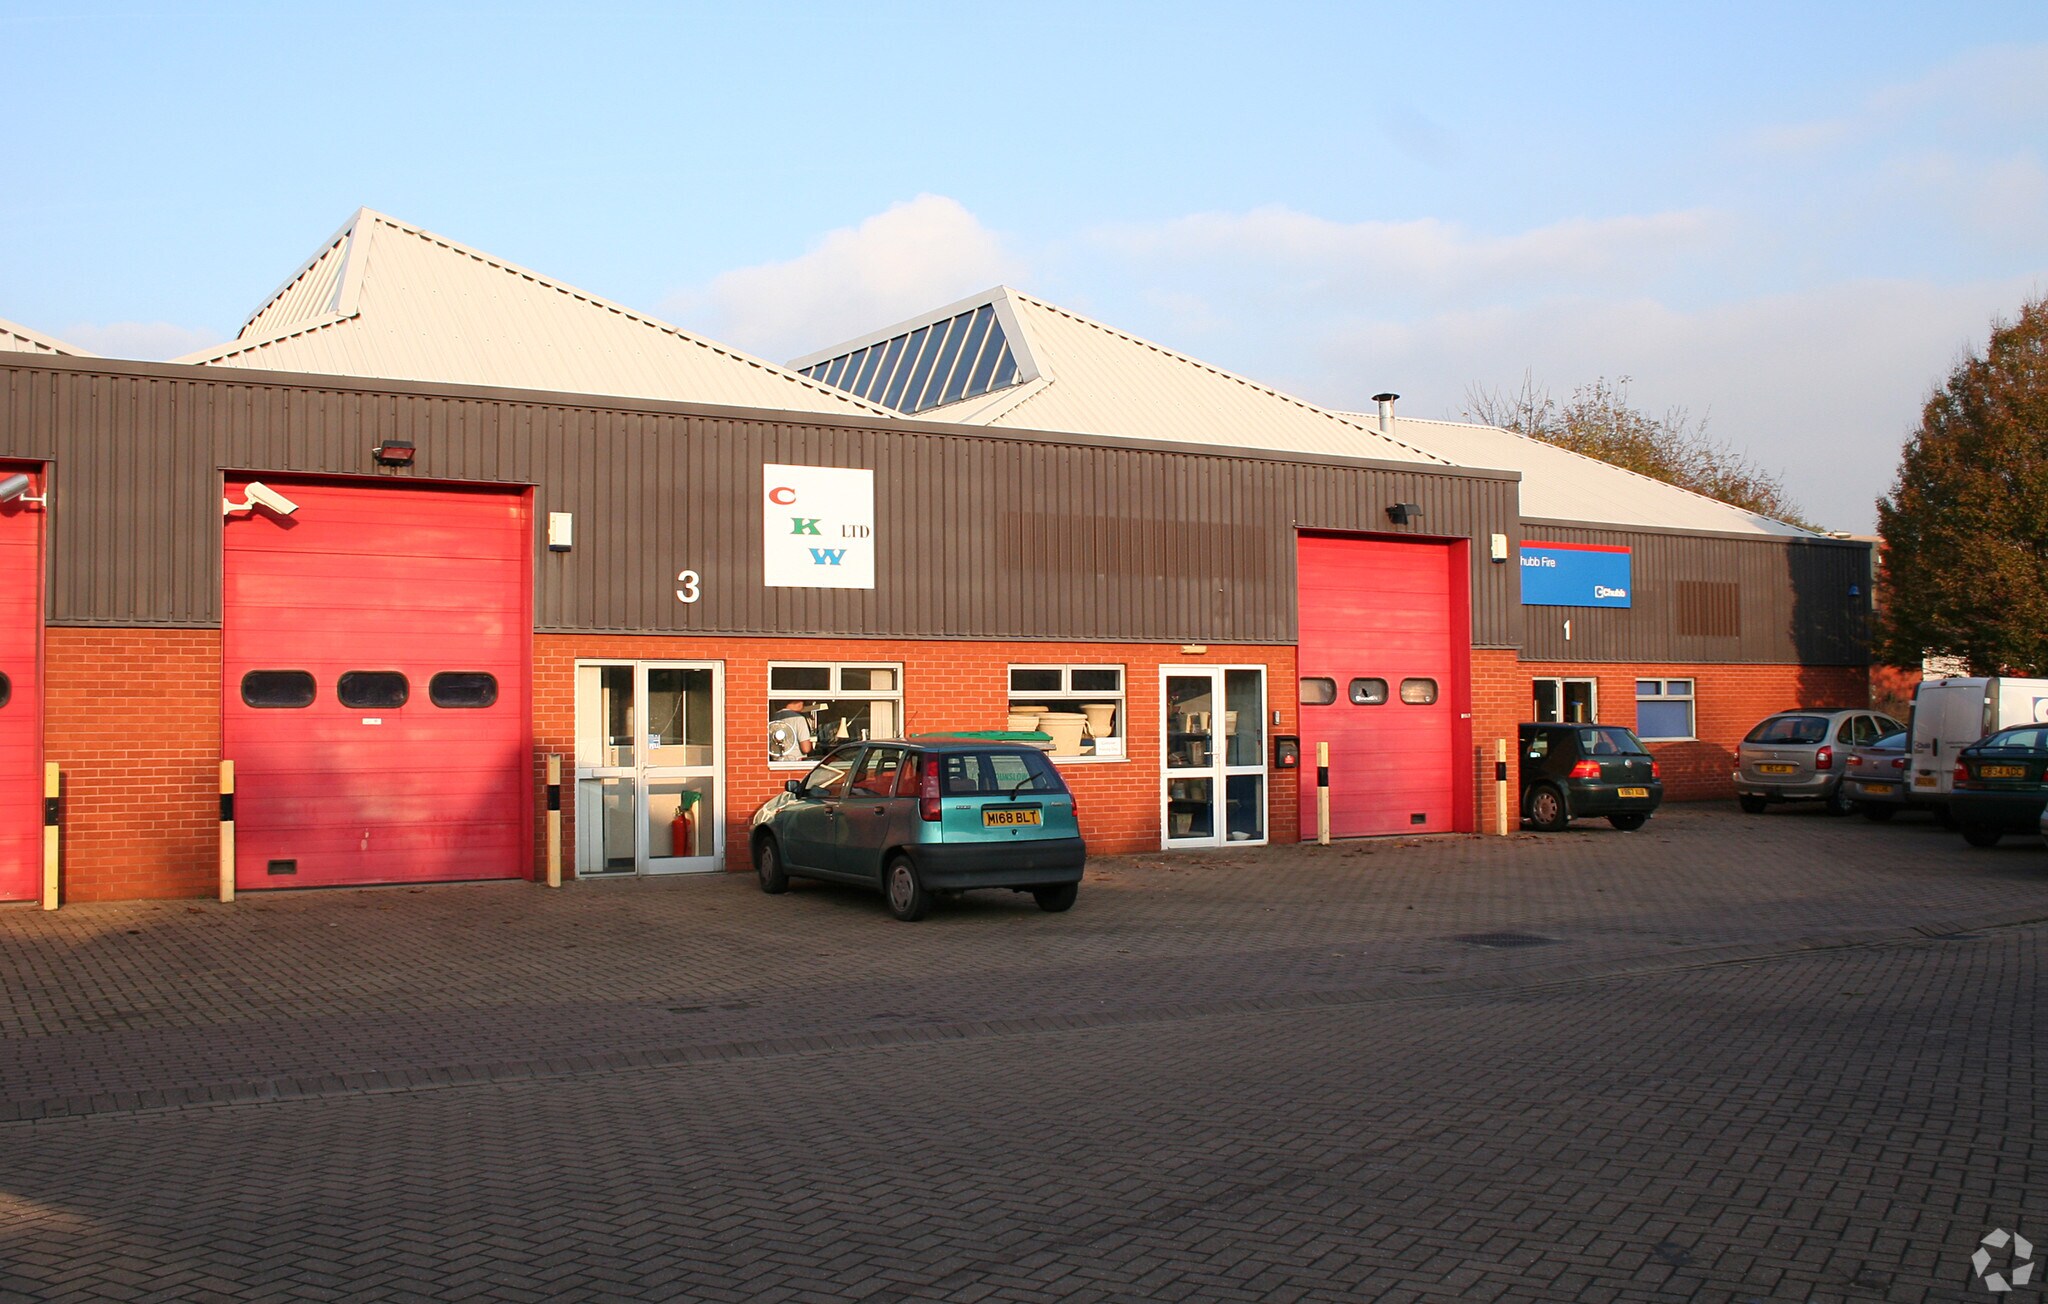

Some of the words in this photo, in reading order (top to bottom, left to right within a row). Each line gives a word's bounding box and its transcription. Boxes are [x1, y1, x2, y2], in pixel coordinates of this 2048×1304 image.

[769, 486, 797, 506] C
[790, 517, 822, 536] K
[841, 524, 870, 539] LTD
[808, 547, 848, 566] W
[1520, 555, 1541, 567] hubb
[1541, 556, 1556, 568] Fire
[676, 569, 701, 604] 3
[1563, 619, 1571, 641] 1
[987, 812, 1013, 825] M168
[1016, 811, 1037, 824] BLT
